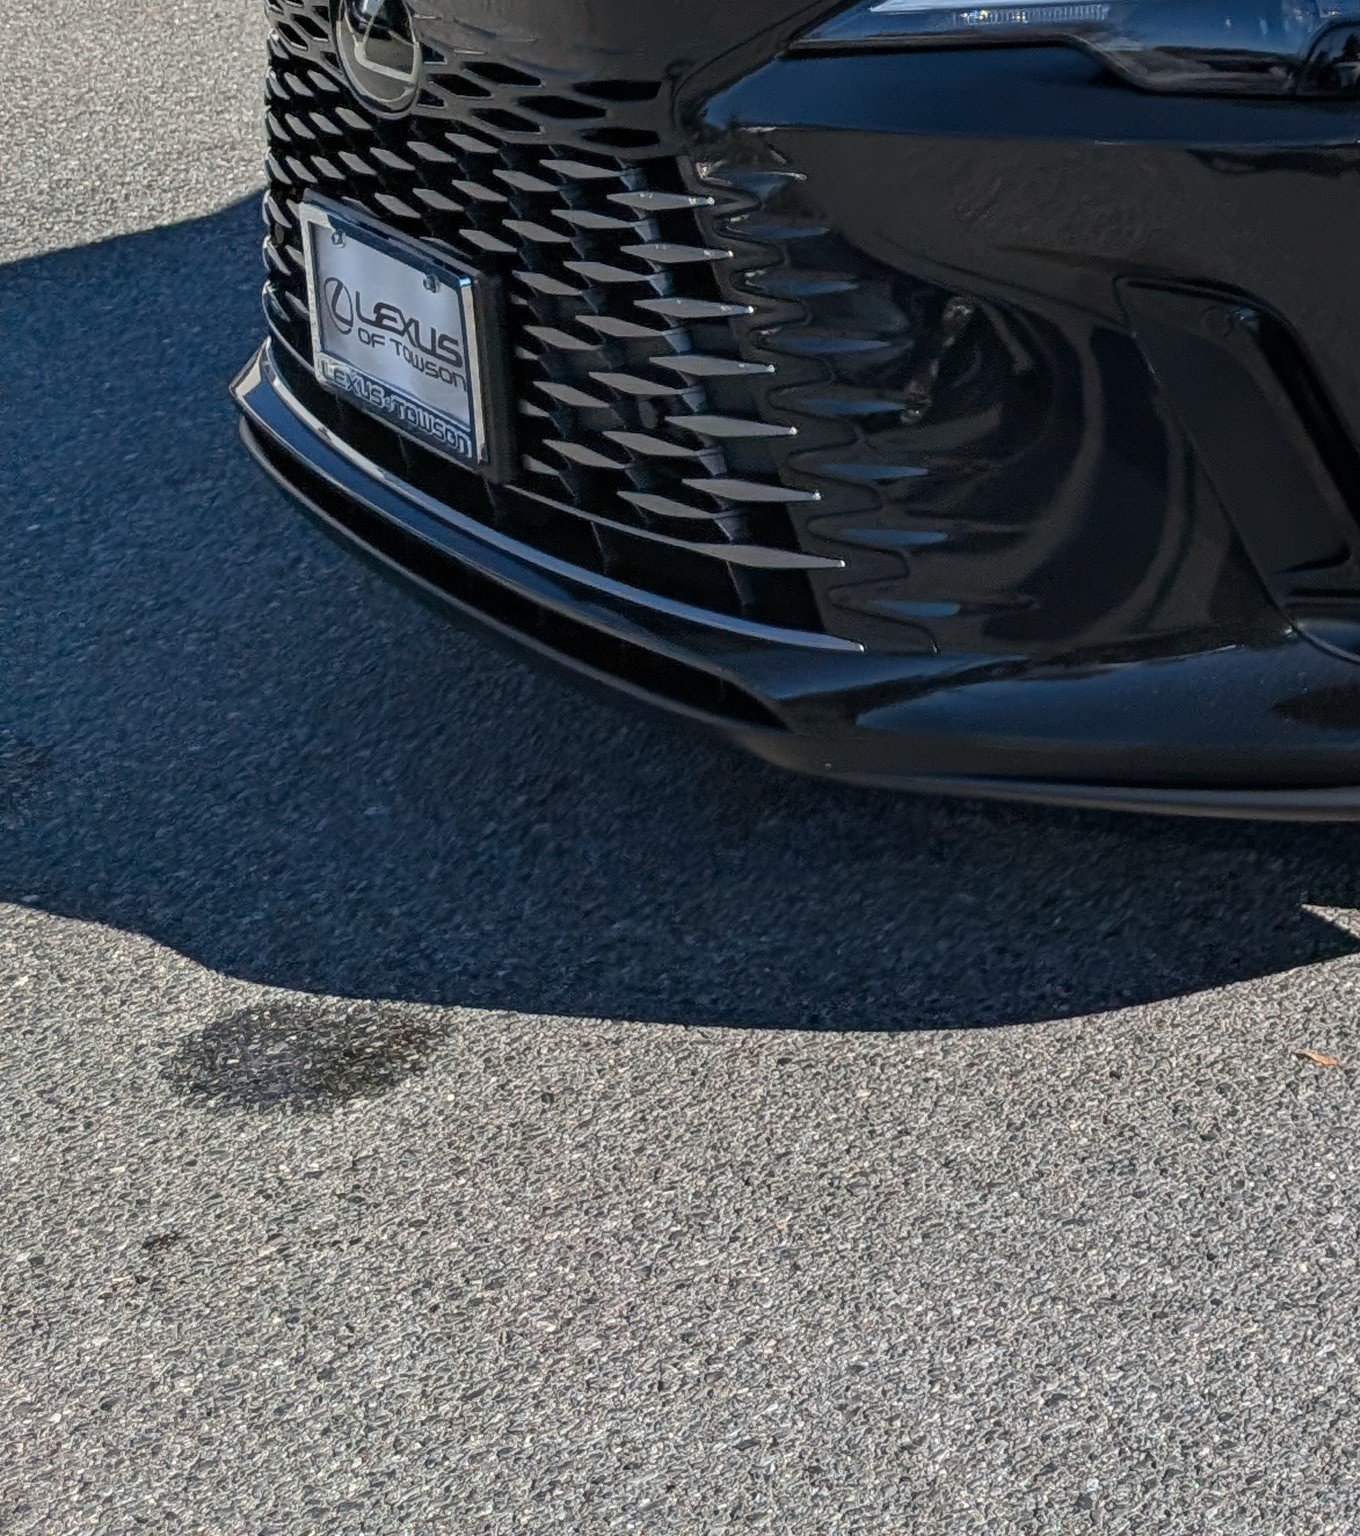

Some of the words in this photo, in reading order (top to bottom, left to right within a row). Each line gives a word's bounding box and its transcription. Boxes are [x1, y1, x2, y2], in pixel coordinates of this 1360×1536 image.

[355, 291, 463, 368] LEXUS
[358, 327, 385, 348] OF
[321, 360, 384, 408] LEXUS
